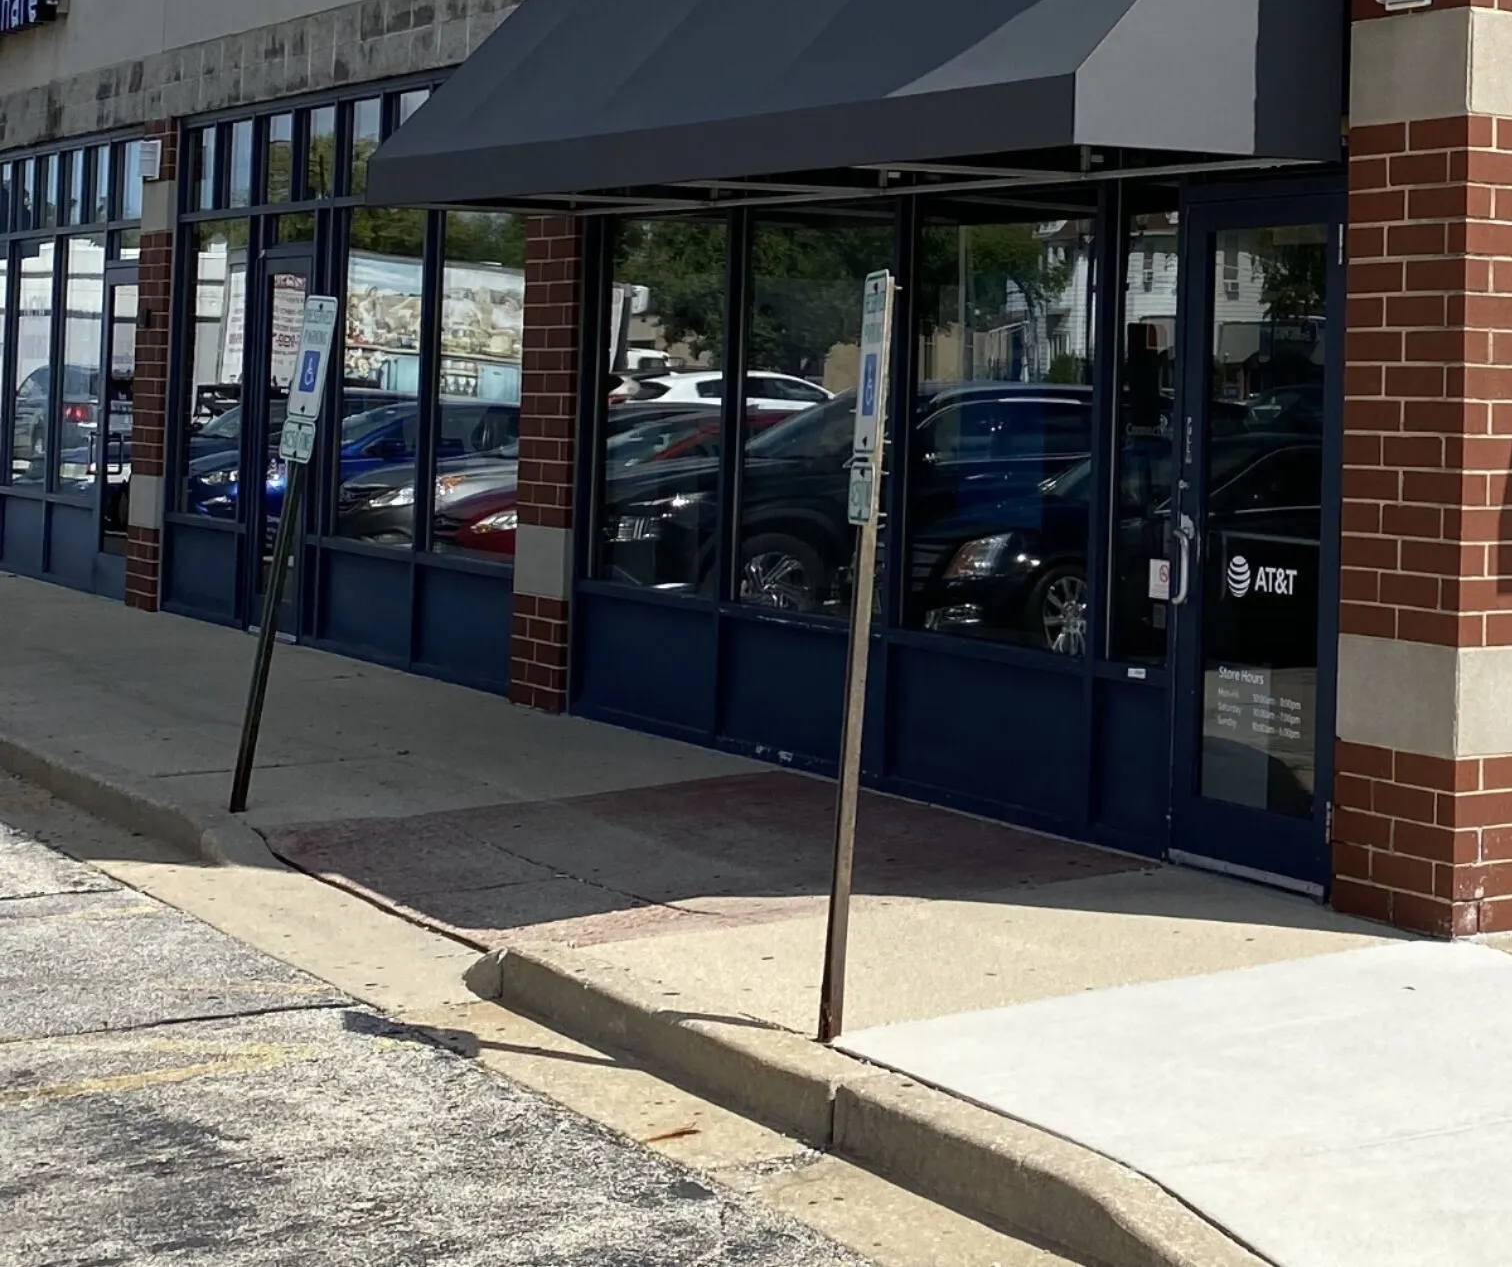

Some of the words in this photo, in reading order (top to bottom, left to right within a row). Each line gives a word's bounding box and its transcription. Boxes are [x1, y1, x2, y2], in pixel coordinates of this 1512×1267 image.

[1254, 566, 1298, 595] AT&T
[1218, 665, 1240, 681] Store
[1241, 669, 1264, 685] Hours
